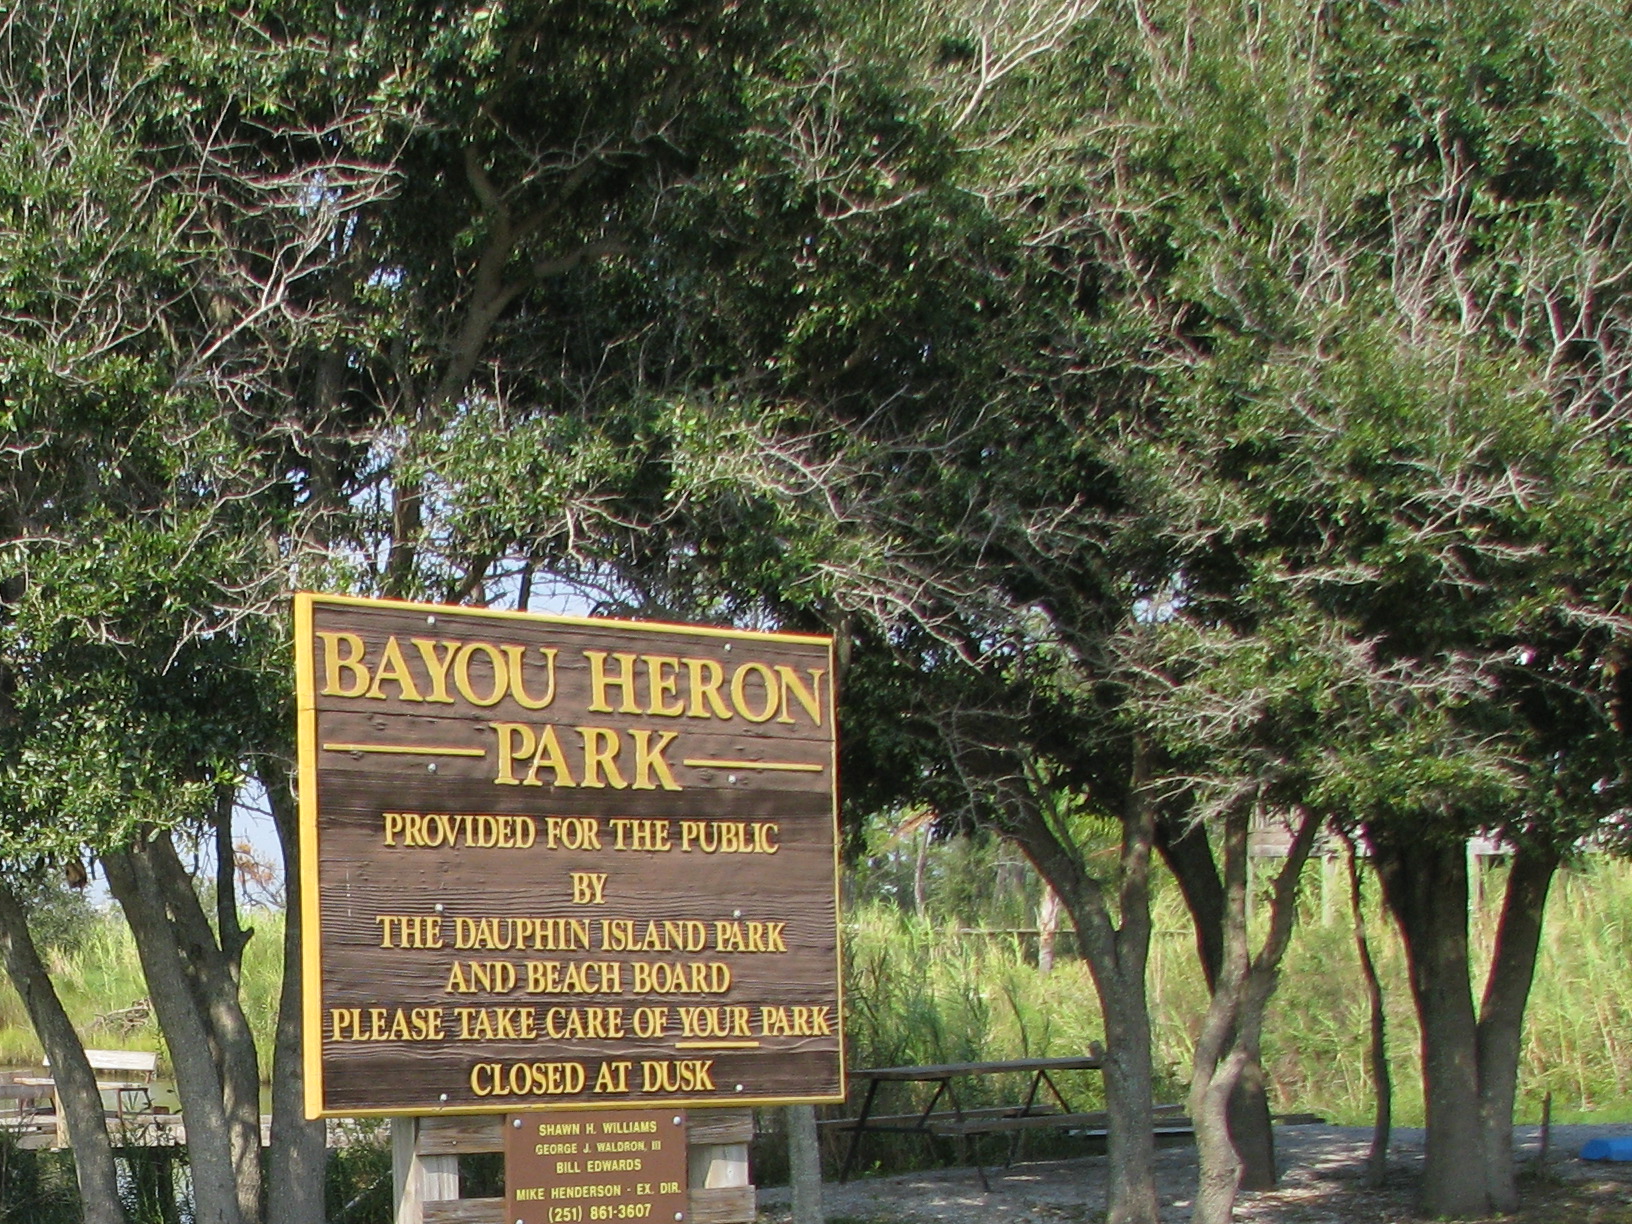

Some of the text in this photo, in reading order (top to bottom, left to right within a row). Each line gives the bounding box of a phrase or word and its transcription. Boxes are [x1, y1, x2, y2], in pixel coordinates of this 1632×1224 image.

[316, 631, 826, 727] BAYOU HERON
[490, 722, 683, 791] PARK
[382, 813, 778, 854] PROVIDED FOR THE PUBLIC
[569, 872, 607, 904] BY
[376, 915, 787, 952] THE DAUPHIN ISLAND PARK
[445, 961, 732, 994] AND BEACH BOARD
[330, 1007, 831, 1042] PLEASE TAKE CARE OF YOUR PARK
[470, 1060, 715, 1096] CLOSED AT DUSK
[539, 1121, 657, 1136] SHAWN H. WILLIAMS
[535, 1143, 577, 1155] GEORGE
[583, 1143, 591, 1153] J.
[652, 1141, 661, 1150] III
[556, 1159, 642, 1174] BILL EDWARDS
[516, 1188, 545, 1201] MIKE
[551, 1185, 621, 1199] HENDERSON
[637, 1184, 654, 1195] EX.
[660, 1182, 682, 1194] DIR.
[548, 1204, 652, 1223] (251) 861-3607
